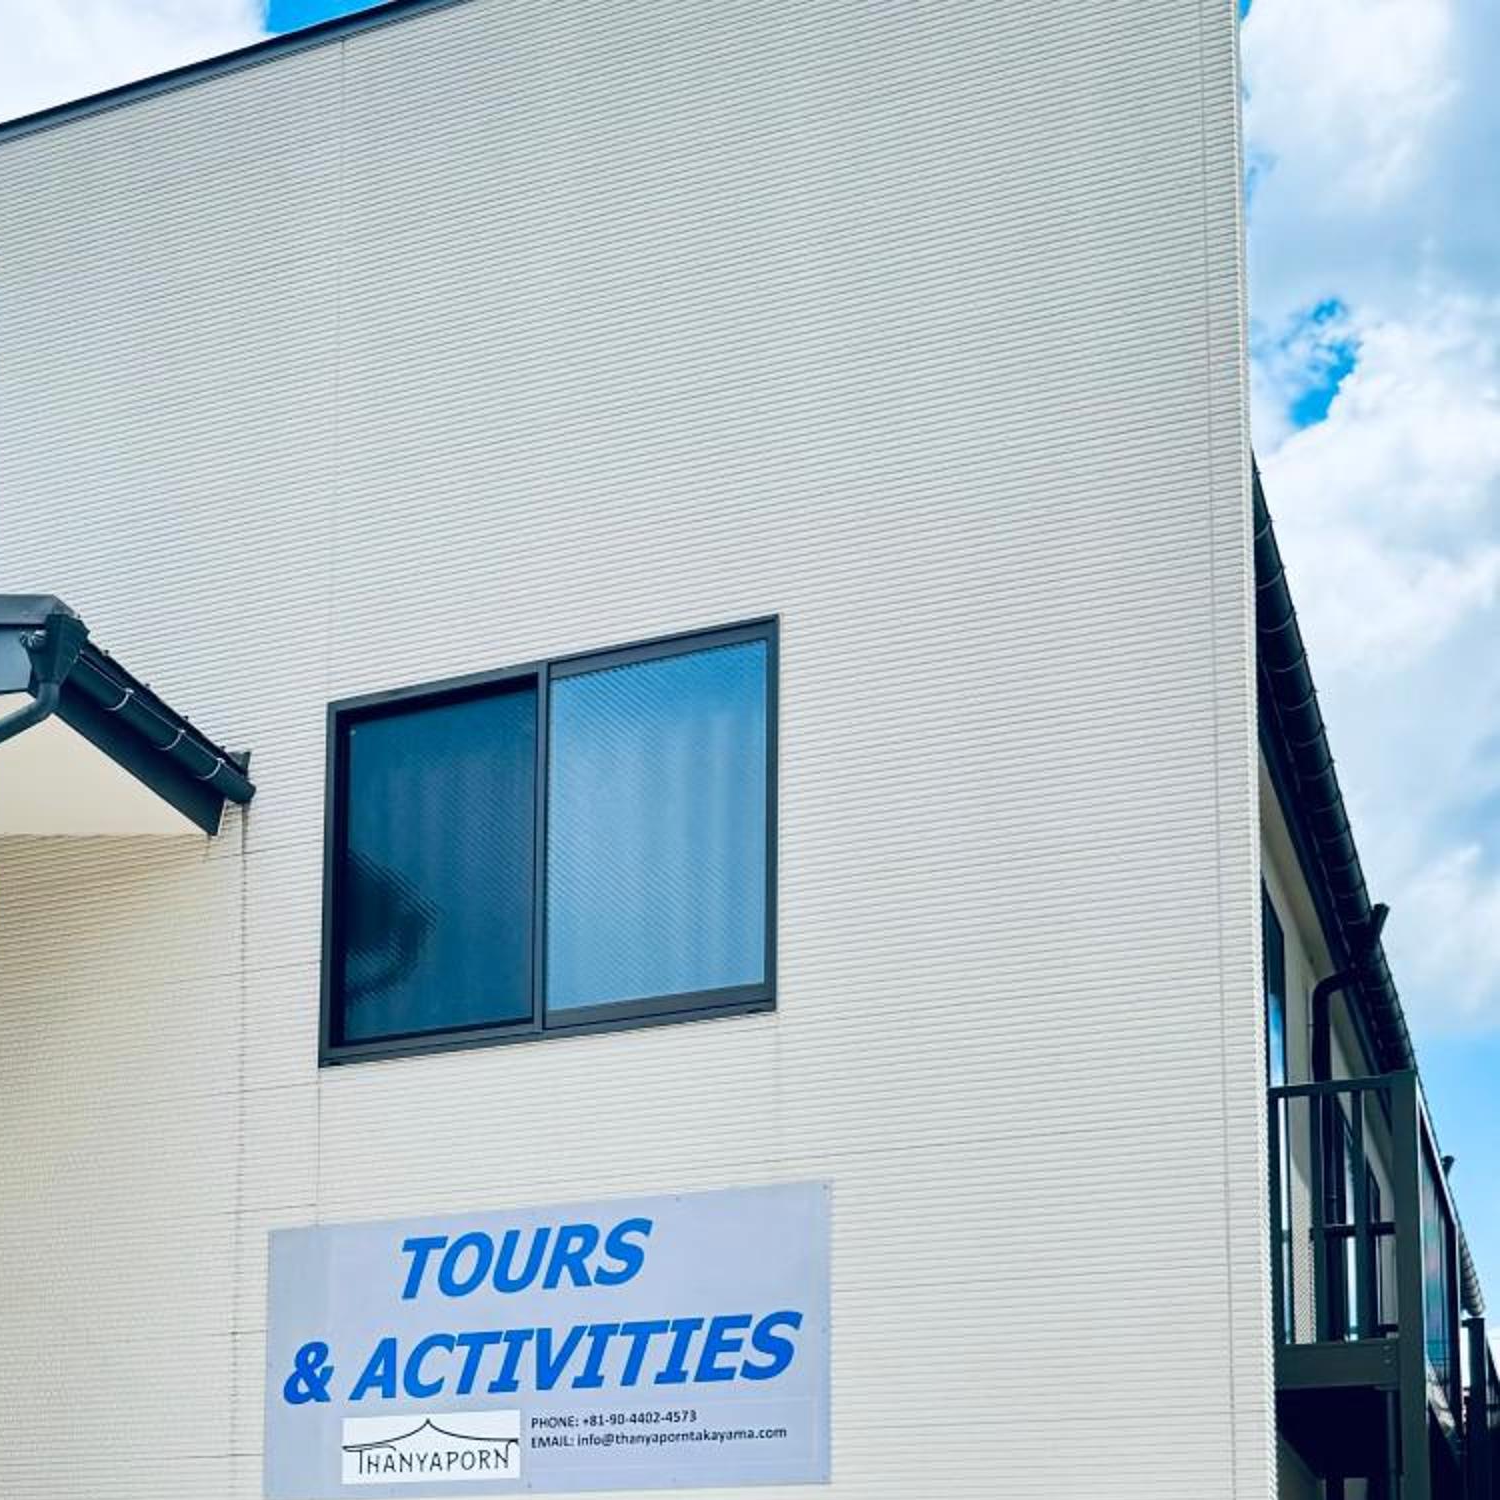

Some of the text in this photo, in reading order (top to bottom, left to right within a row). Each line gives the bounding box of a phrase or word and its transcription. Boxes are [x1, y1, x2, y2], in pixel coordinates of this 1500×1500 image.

[400, 1217, 653, 1300] TOURS
[282, 1310, 803, 1405] & ACTIVITIES
[531, 1409, 698, 1429] PHONE: +81-90-4402-4573
[531, 1427, 787, 1449] EMAIL: info@thanyaporntakayama.com
[357, 1441, 512, 1476] THANYAPORN
